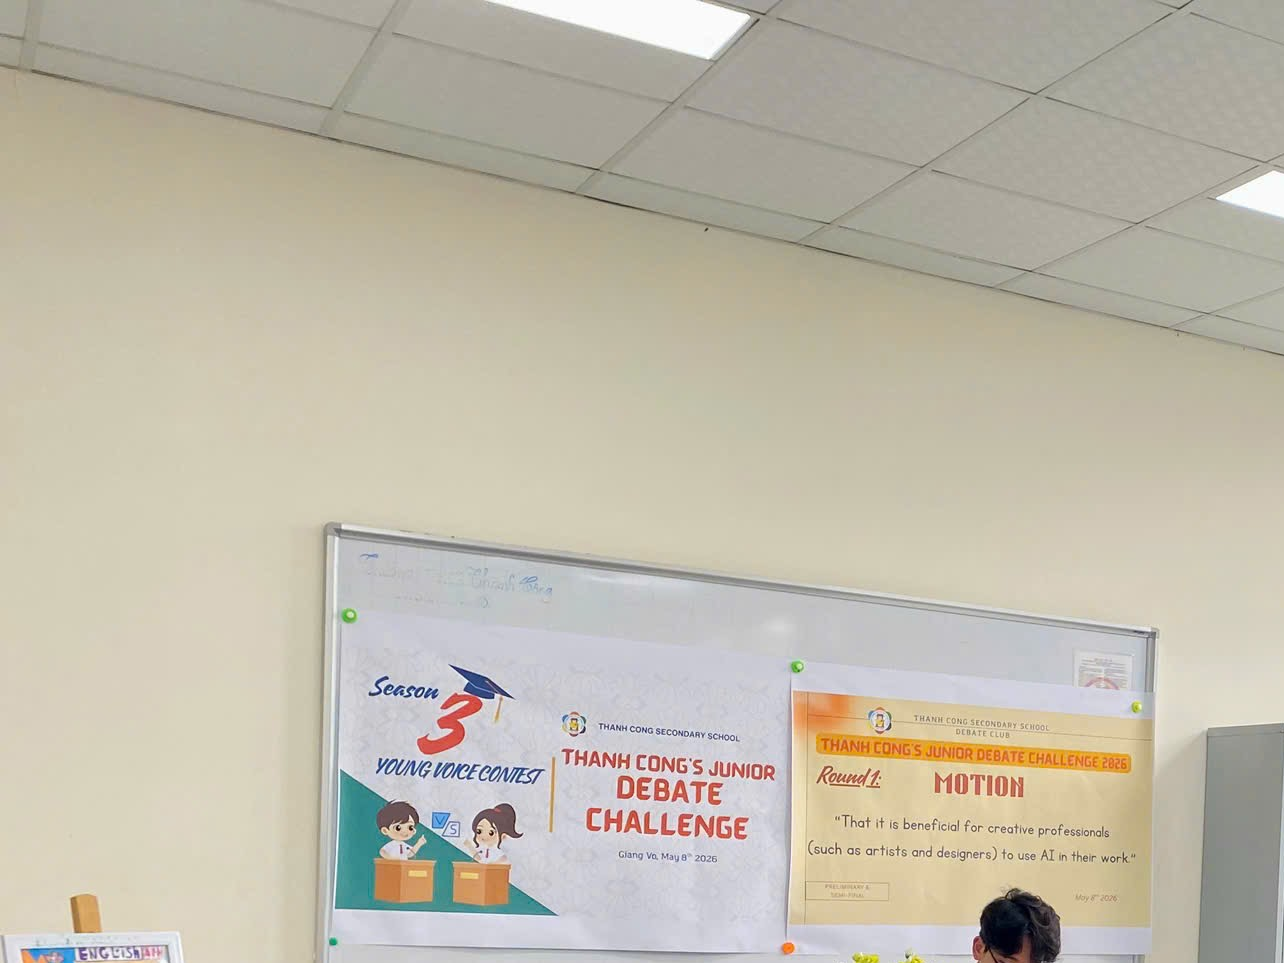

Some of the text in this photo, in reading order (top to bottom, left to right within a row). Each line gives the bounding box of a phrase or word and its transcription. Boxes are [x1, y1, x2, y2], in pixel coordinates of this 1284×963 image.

[368, 676, 440, 700] Season
[417, 693, 483, 755] 3
[598, 722, 741, 742] THANH CONG SECONDARY SCHOOL
[914, 714, 1051, 732] THANH CONG SECONDARY SCHOOL
[956, 728, 1010, 739] DEBATE CLUB
[561, 748, 776, 781] THANH CONG'S JUNIOR
[821, 738, 1128, 770] THANH CONG'S JUNIOR DEBATE CHALLENGE 2026
[375, 757, 546, 785] YOUNG VOICE CONTEST
[816, 765, 871, 787] Round
[616, 775, 724, 805] DEBATE
[934, 771, 1024, 798] MOTION
[585, 807, 749, 840] CHALLENGE
[876, 817, 885, 829] it
[889, 818, 899, 830] is
[904, 818, 960, 832] beneficial
[964, 820, 984, 833] for
[987, 823, 1034, 835] creative
[1038, 824, 1110, 838] professionals
[618, 850, 644, 860] Giang
[661, 853, 680, 862] May
[694, 854, 718, 863] 2026
[807, 839, 842, 856] (such
[847, 847, 861, 856] as
[865, 845, 908, 857] artists
[912, 846, 933, 858] and
[937, 846, 998, 862] designers)
[1002, 848, 1014, 860] to
[1017, 851, 1037, 861] use
[1040, 849, 1055, 862] AI
[1059, 851, 1068, 862] in
[1072, 850, 1096, 863] their
